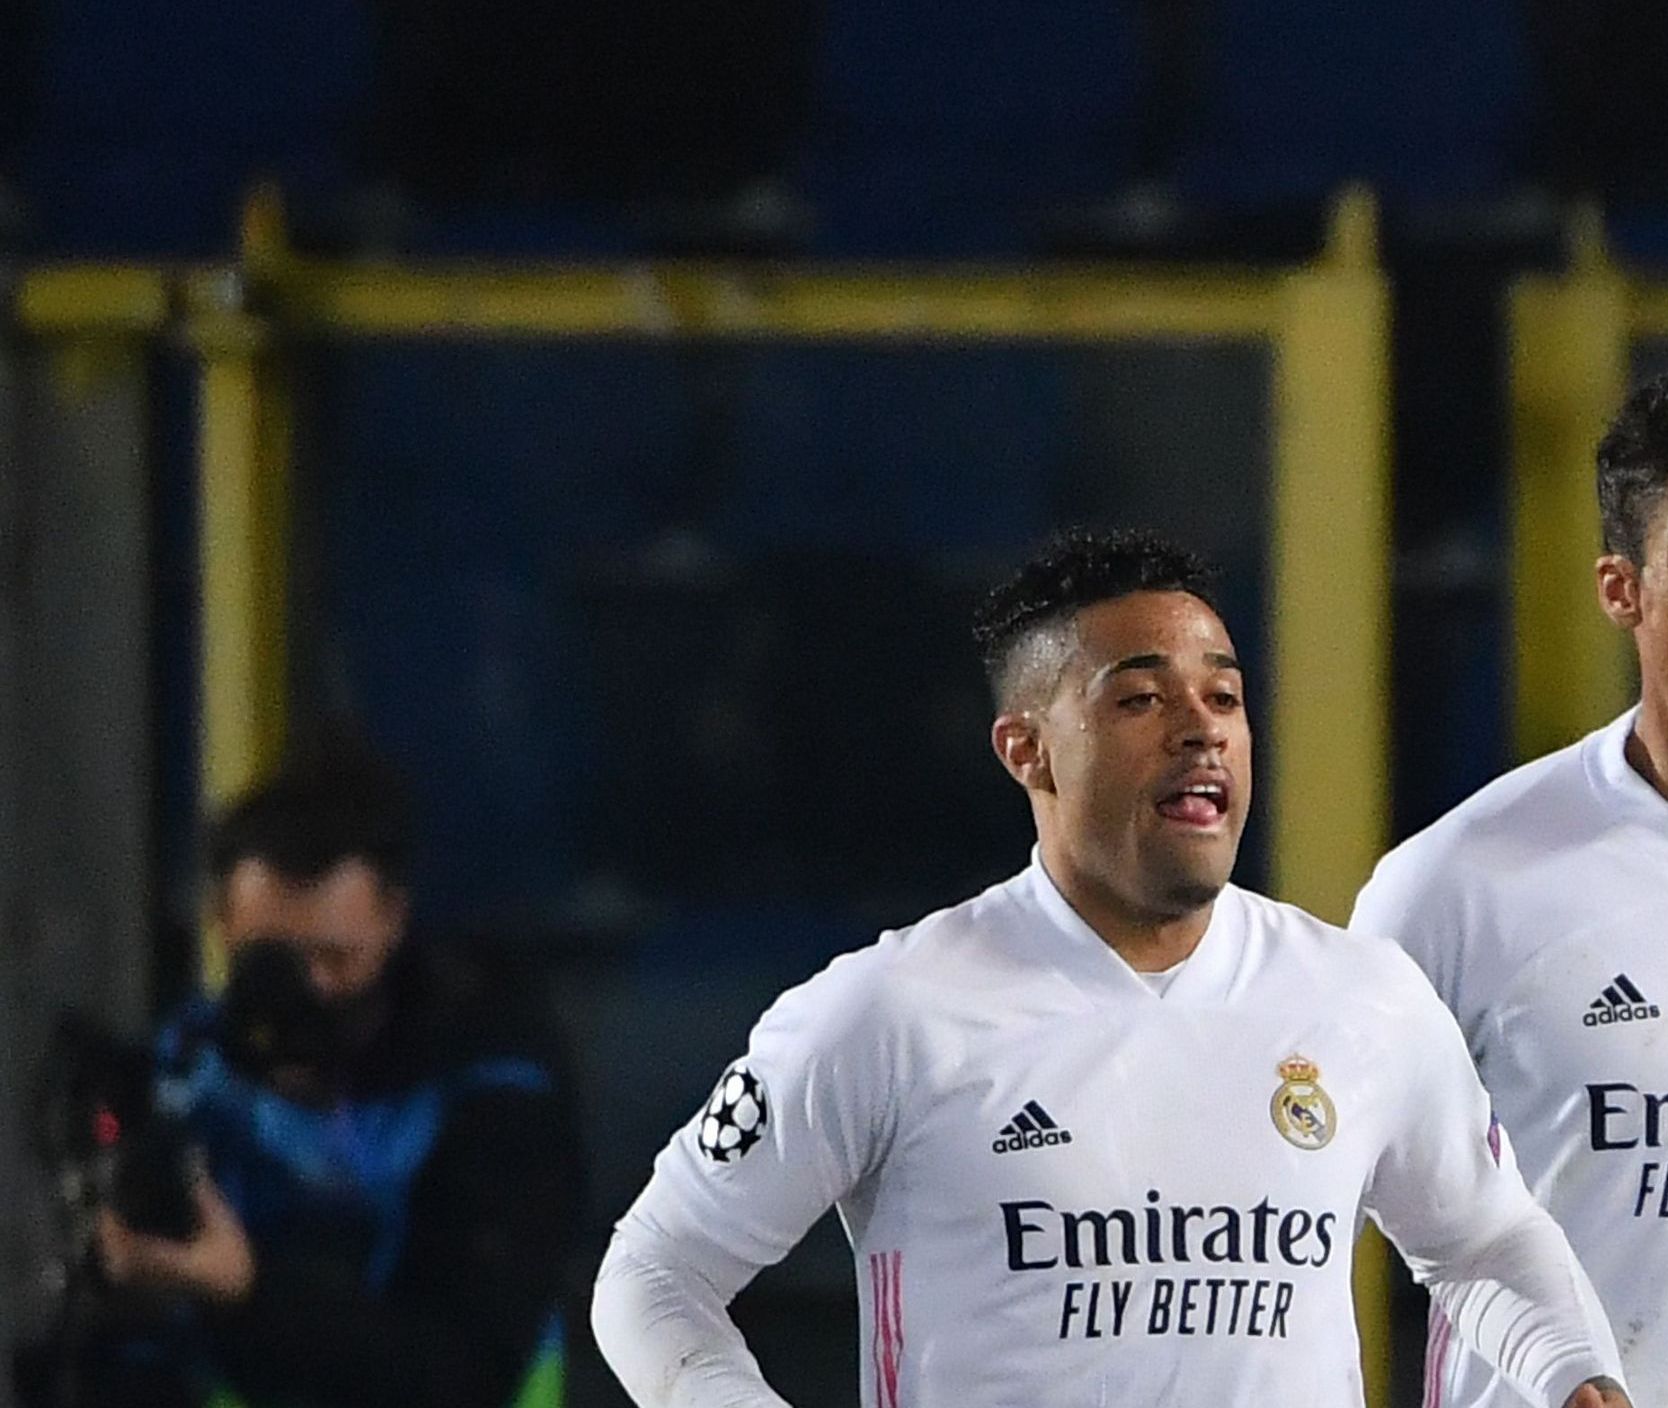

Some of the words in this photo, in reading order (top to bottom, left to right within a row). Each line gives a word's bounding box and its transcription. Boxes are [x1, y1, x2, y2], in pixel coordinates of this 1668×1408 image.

[1582, 1003, 1662, 1027] adidas
[991, 1129, 1073, 1155] adidas
[999, 1189, 1337, 1272] Emirates
[1059, 1280, 1133, 1339] FLY
[1147, 1278, 1294, 1339] BETTER
